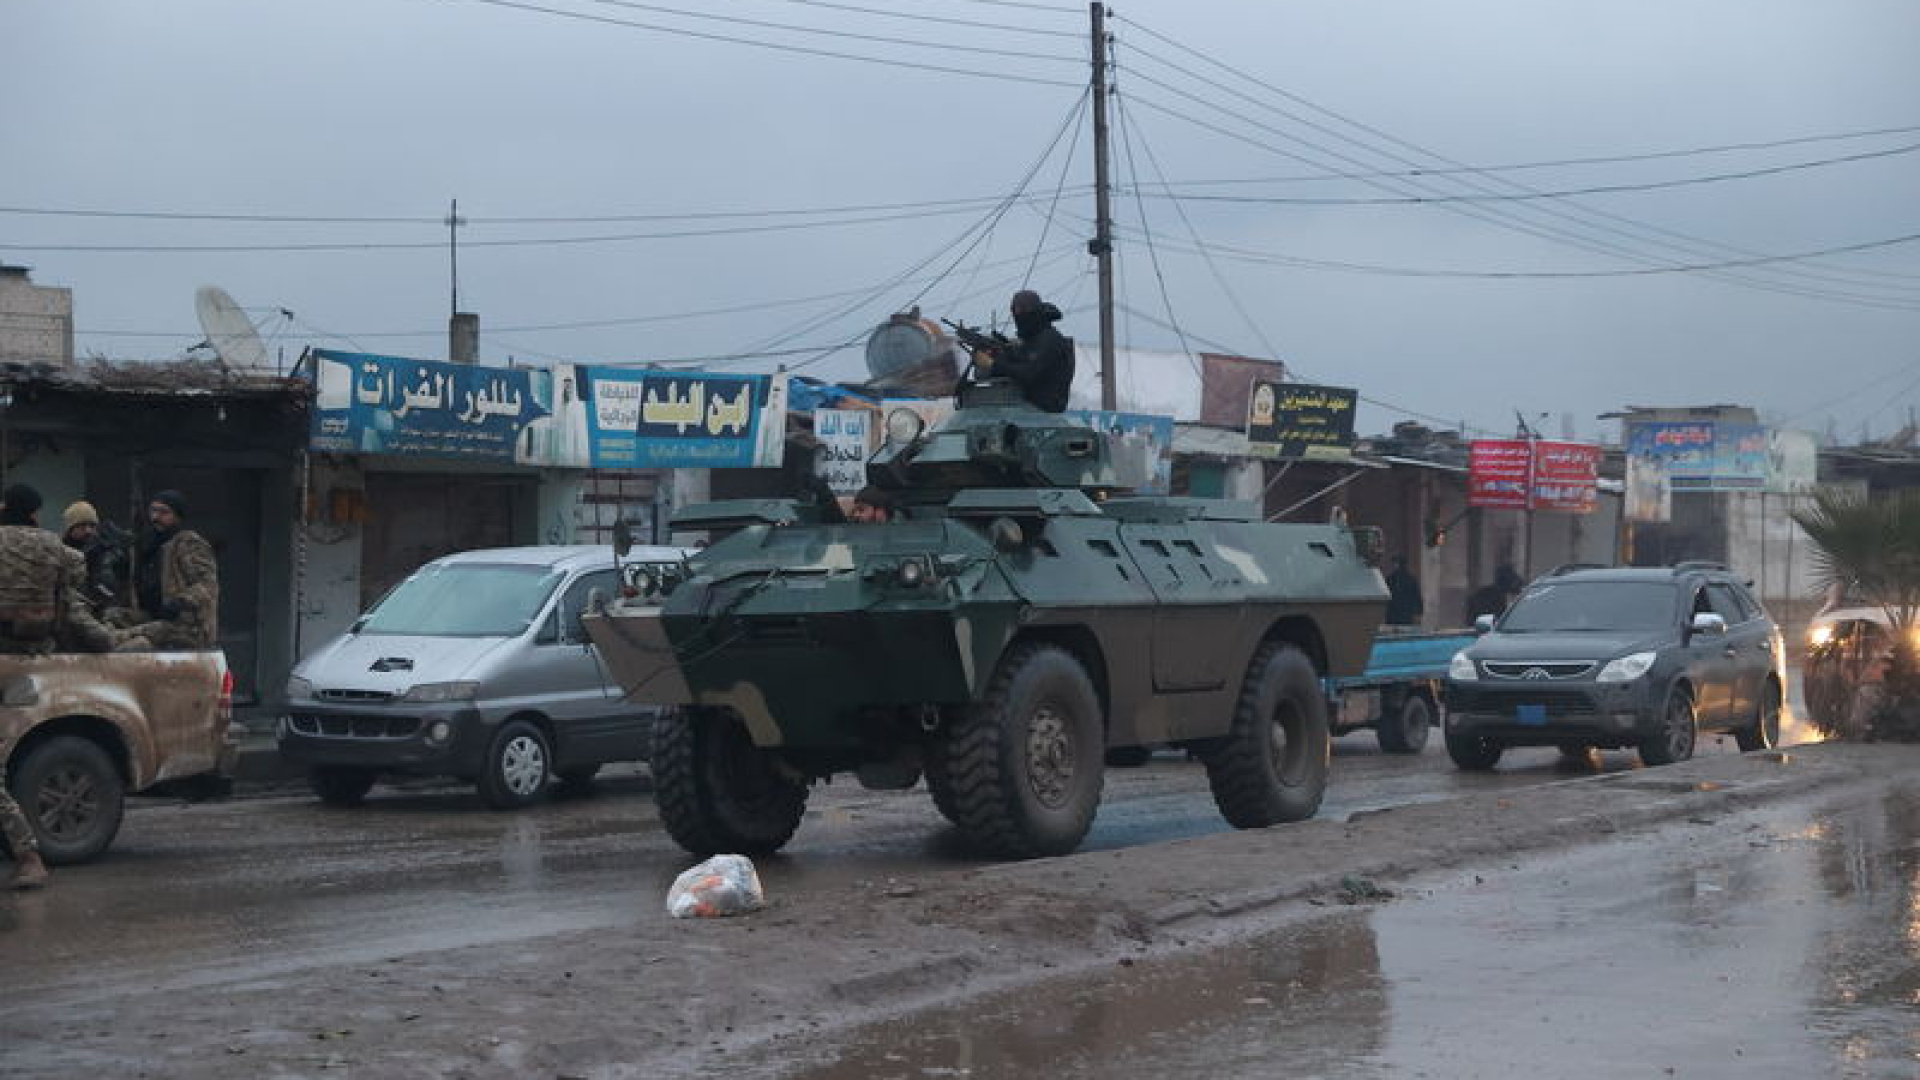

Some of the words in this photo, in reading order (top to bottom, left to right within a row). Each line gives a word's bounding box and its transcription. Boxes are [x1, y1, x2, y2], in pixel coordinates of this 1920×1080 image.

[357, 362, 455, 419] الفرات
[457, 377, 522, 431] بللور
[642, 380, 704, 435] البلد
[707, 383, 750, 435] ابن
